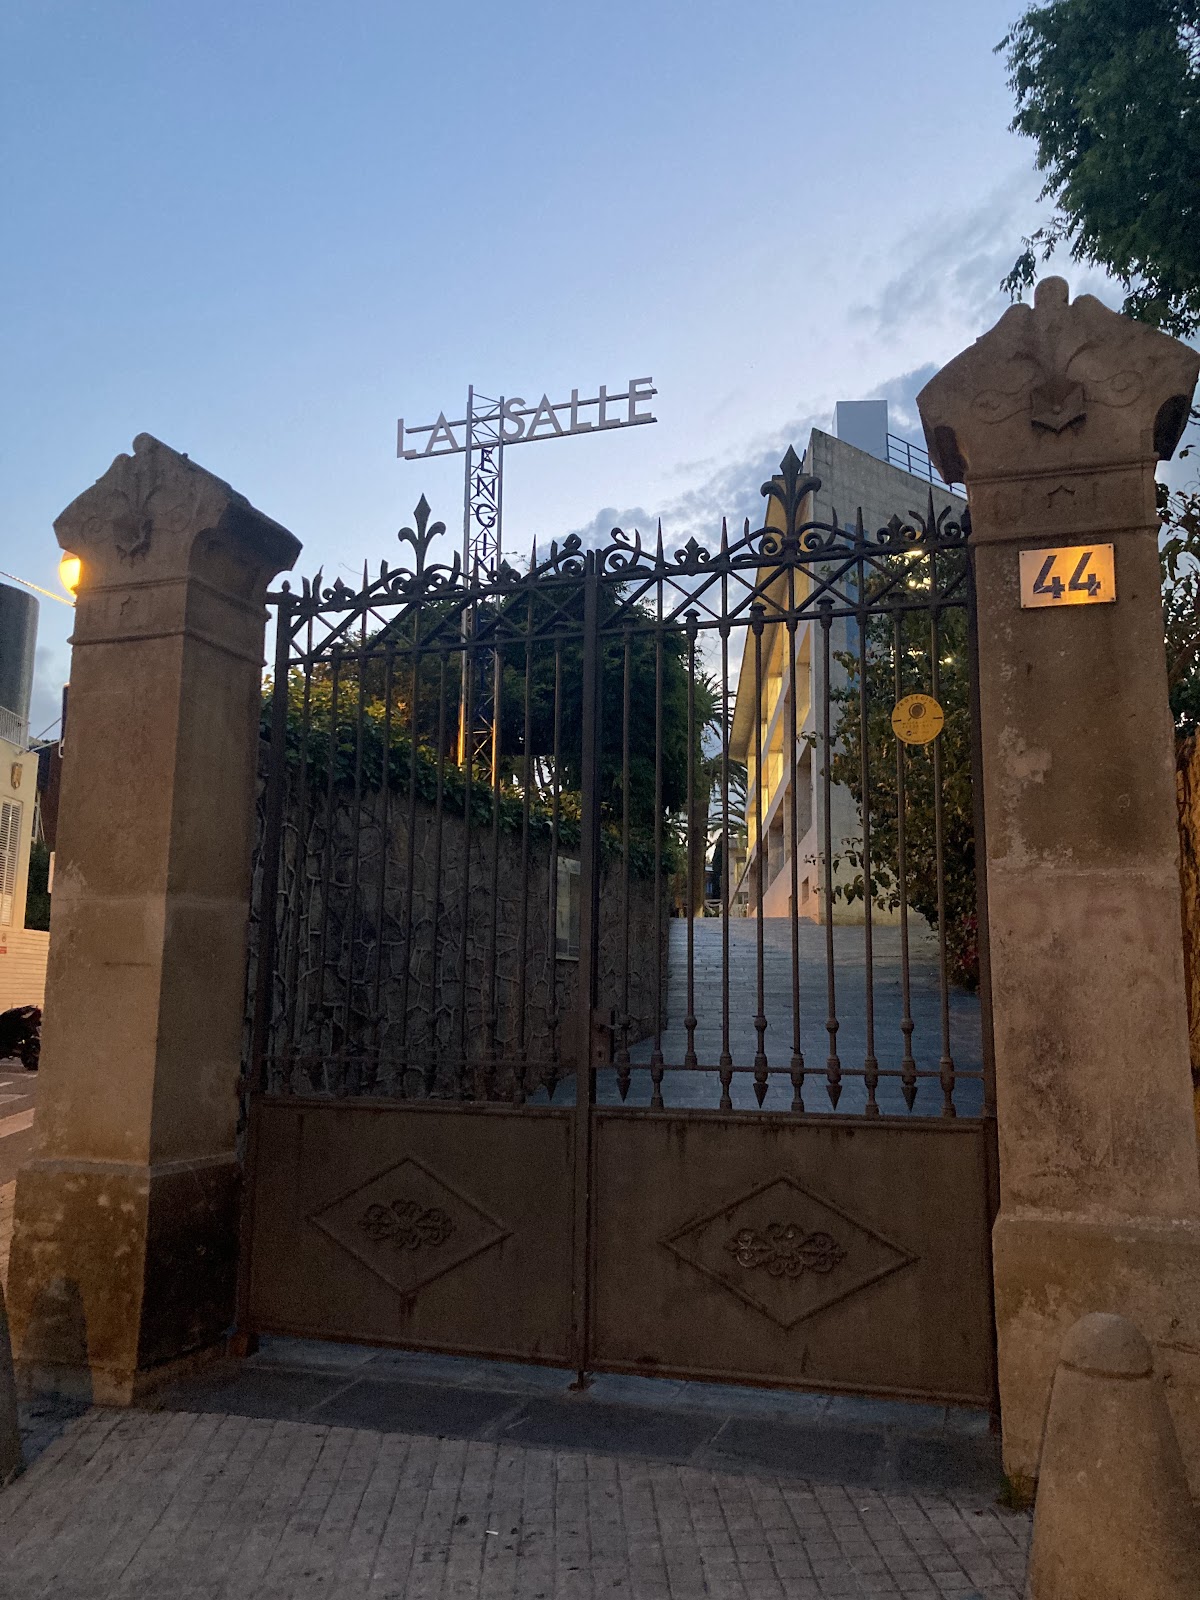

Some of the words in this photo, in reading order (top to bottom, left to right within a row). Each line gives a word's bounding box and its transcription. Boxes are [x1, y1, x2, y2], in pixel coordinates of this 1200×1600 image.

[397, 411, 458, 458] LA
[501, 377, 653, 441] SALLE
[1033, 552, 1101, 598] 44
